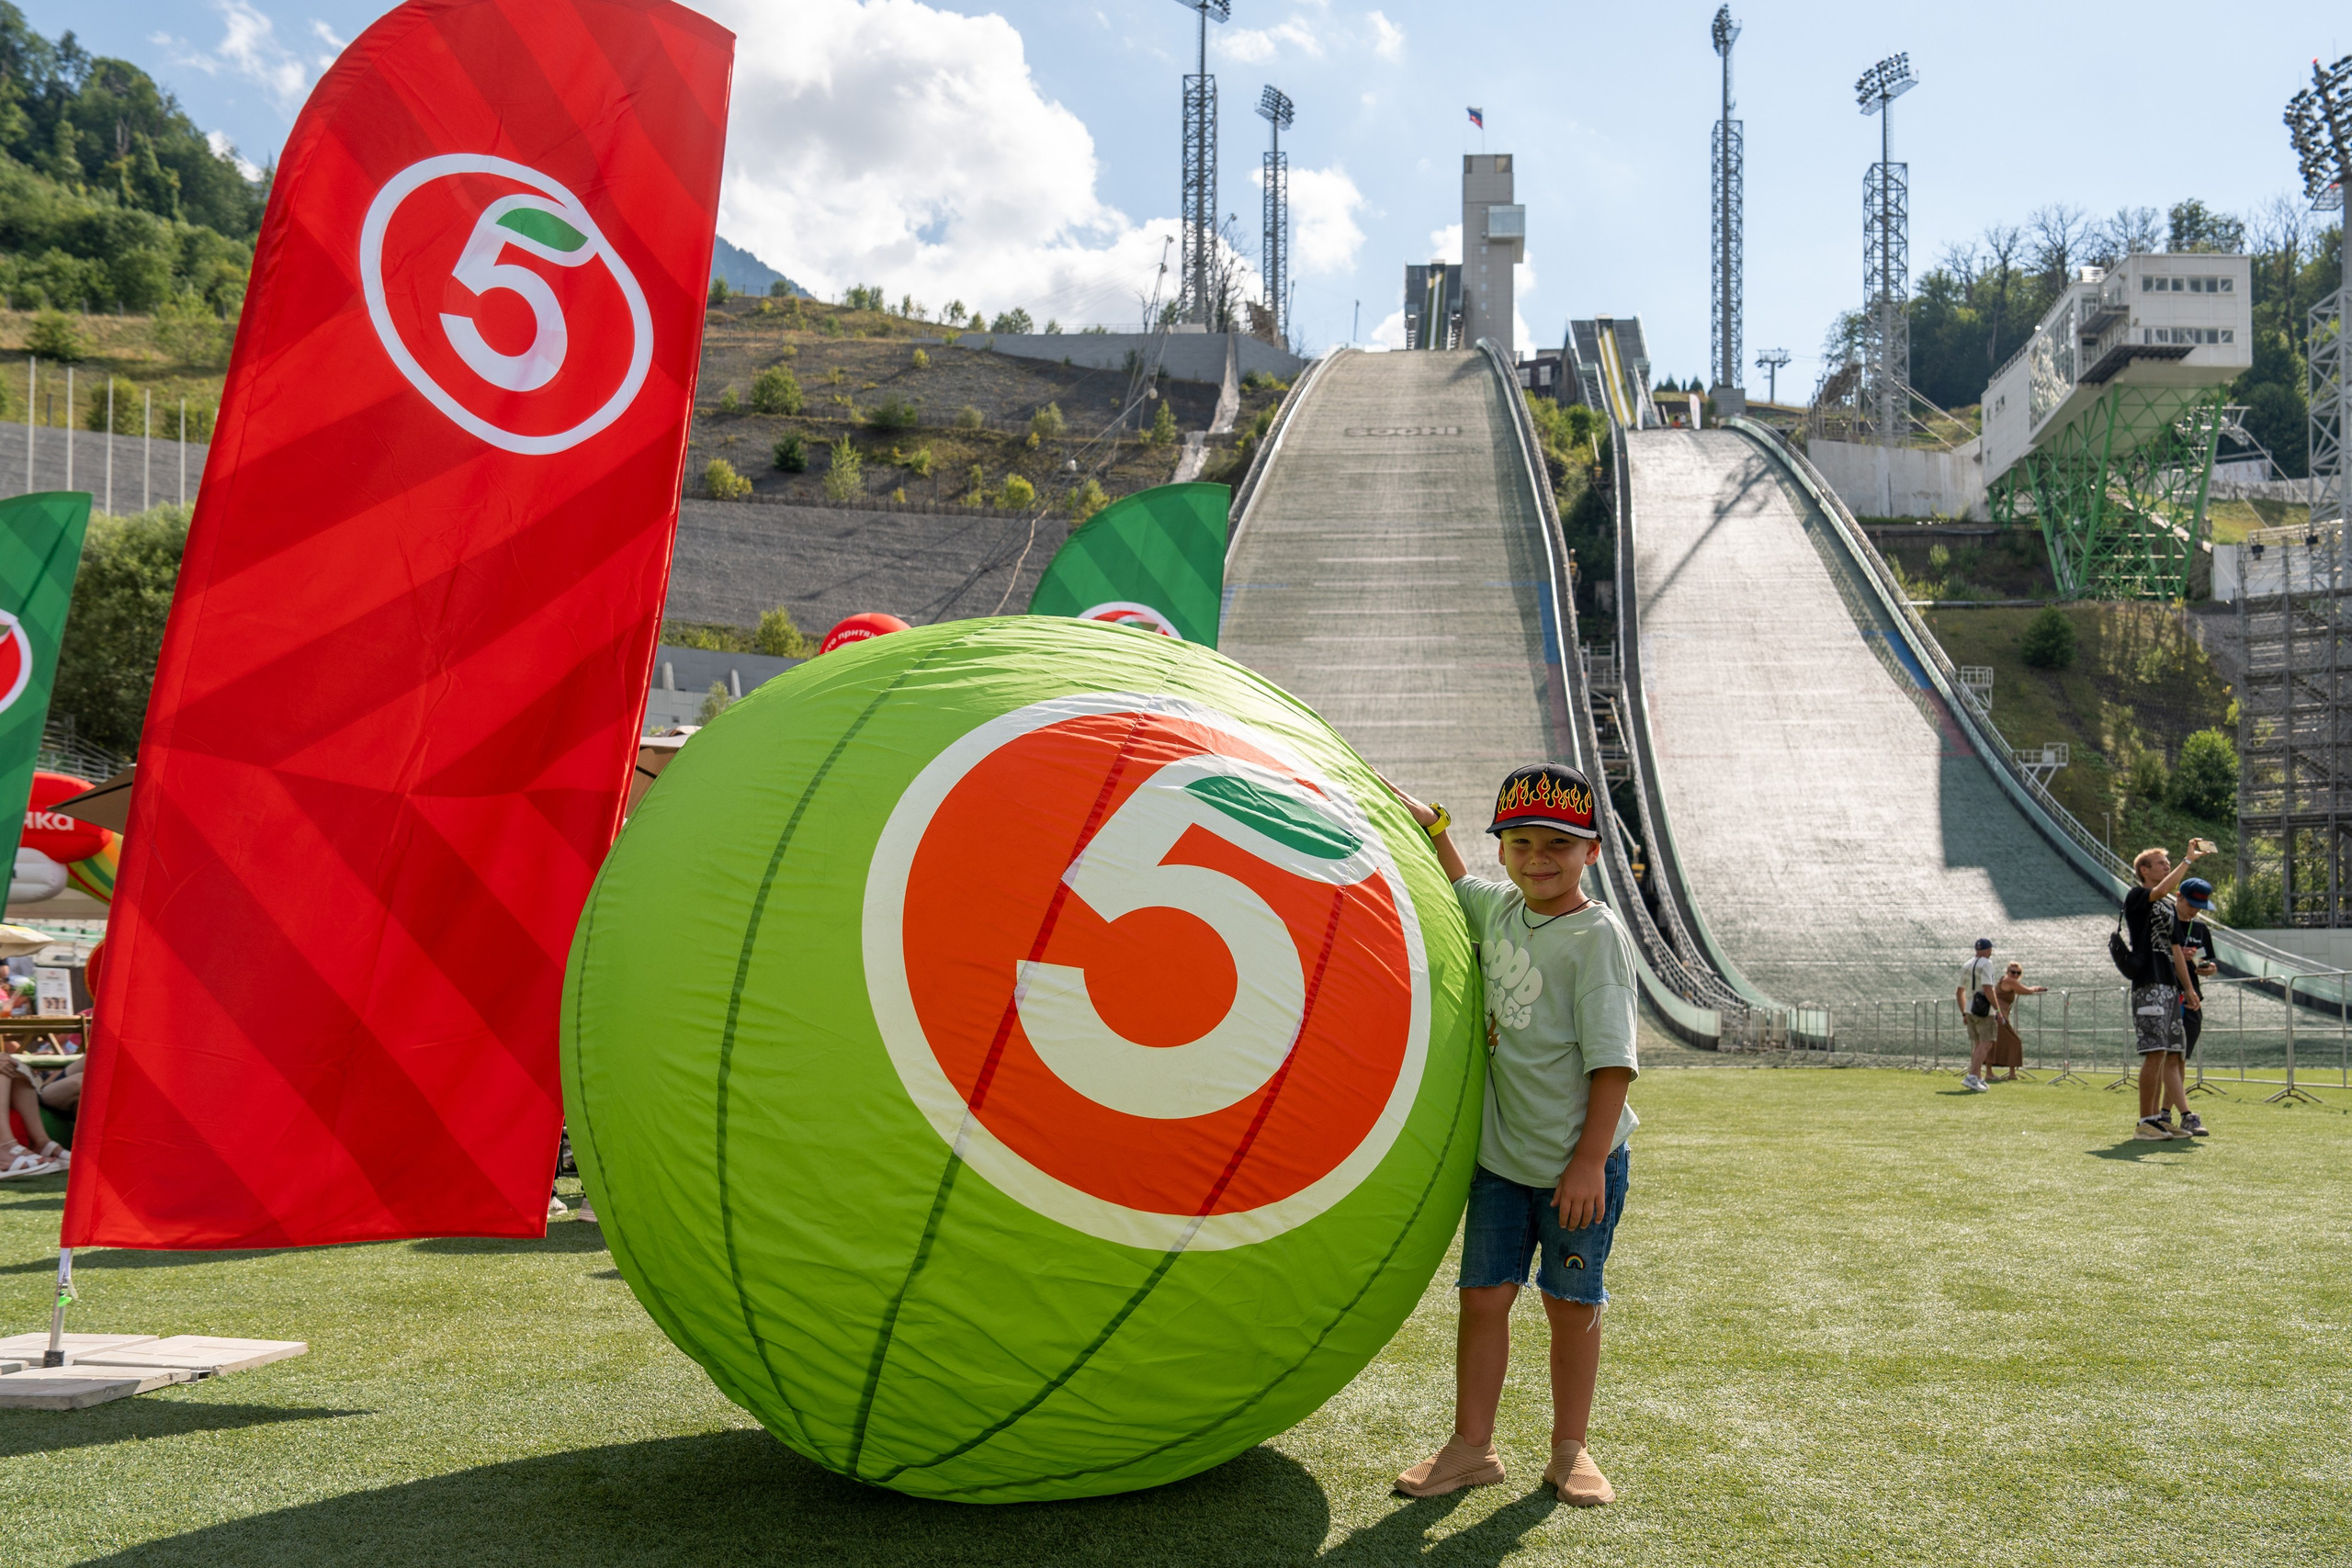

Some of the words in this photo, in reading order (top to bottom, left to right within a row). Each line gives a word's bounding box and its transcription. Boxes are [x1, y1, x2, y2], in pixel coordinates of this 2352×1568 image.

[439, 193, 598, 392] 5
[1344, 426, 1460, 437] SOCHI
[1014, 753, 1378, 1119] 5
